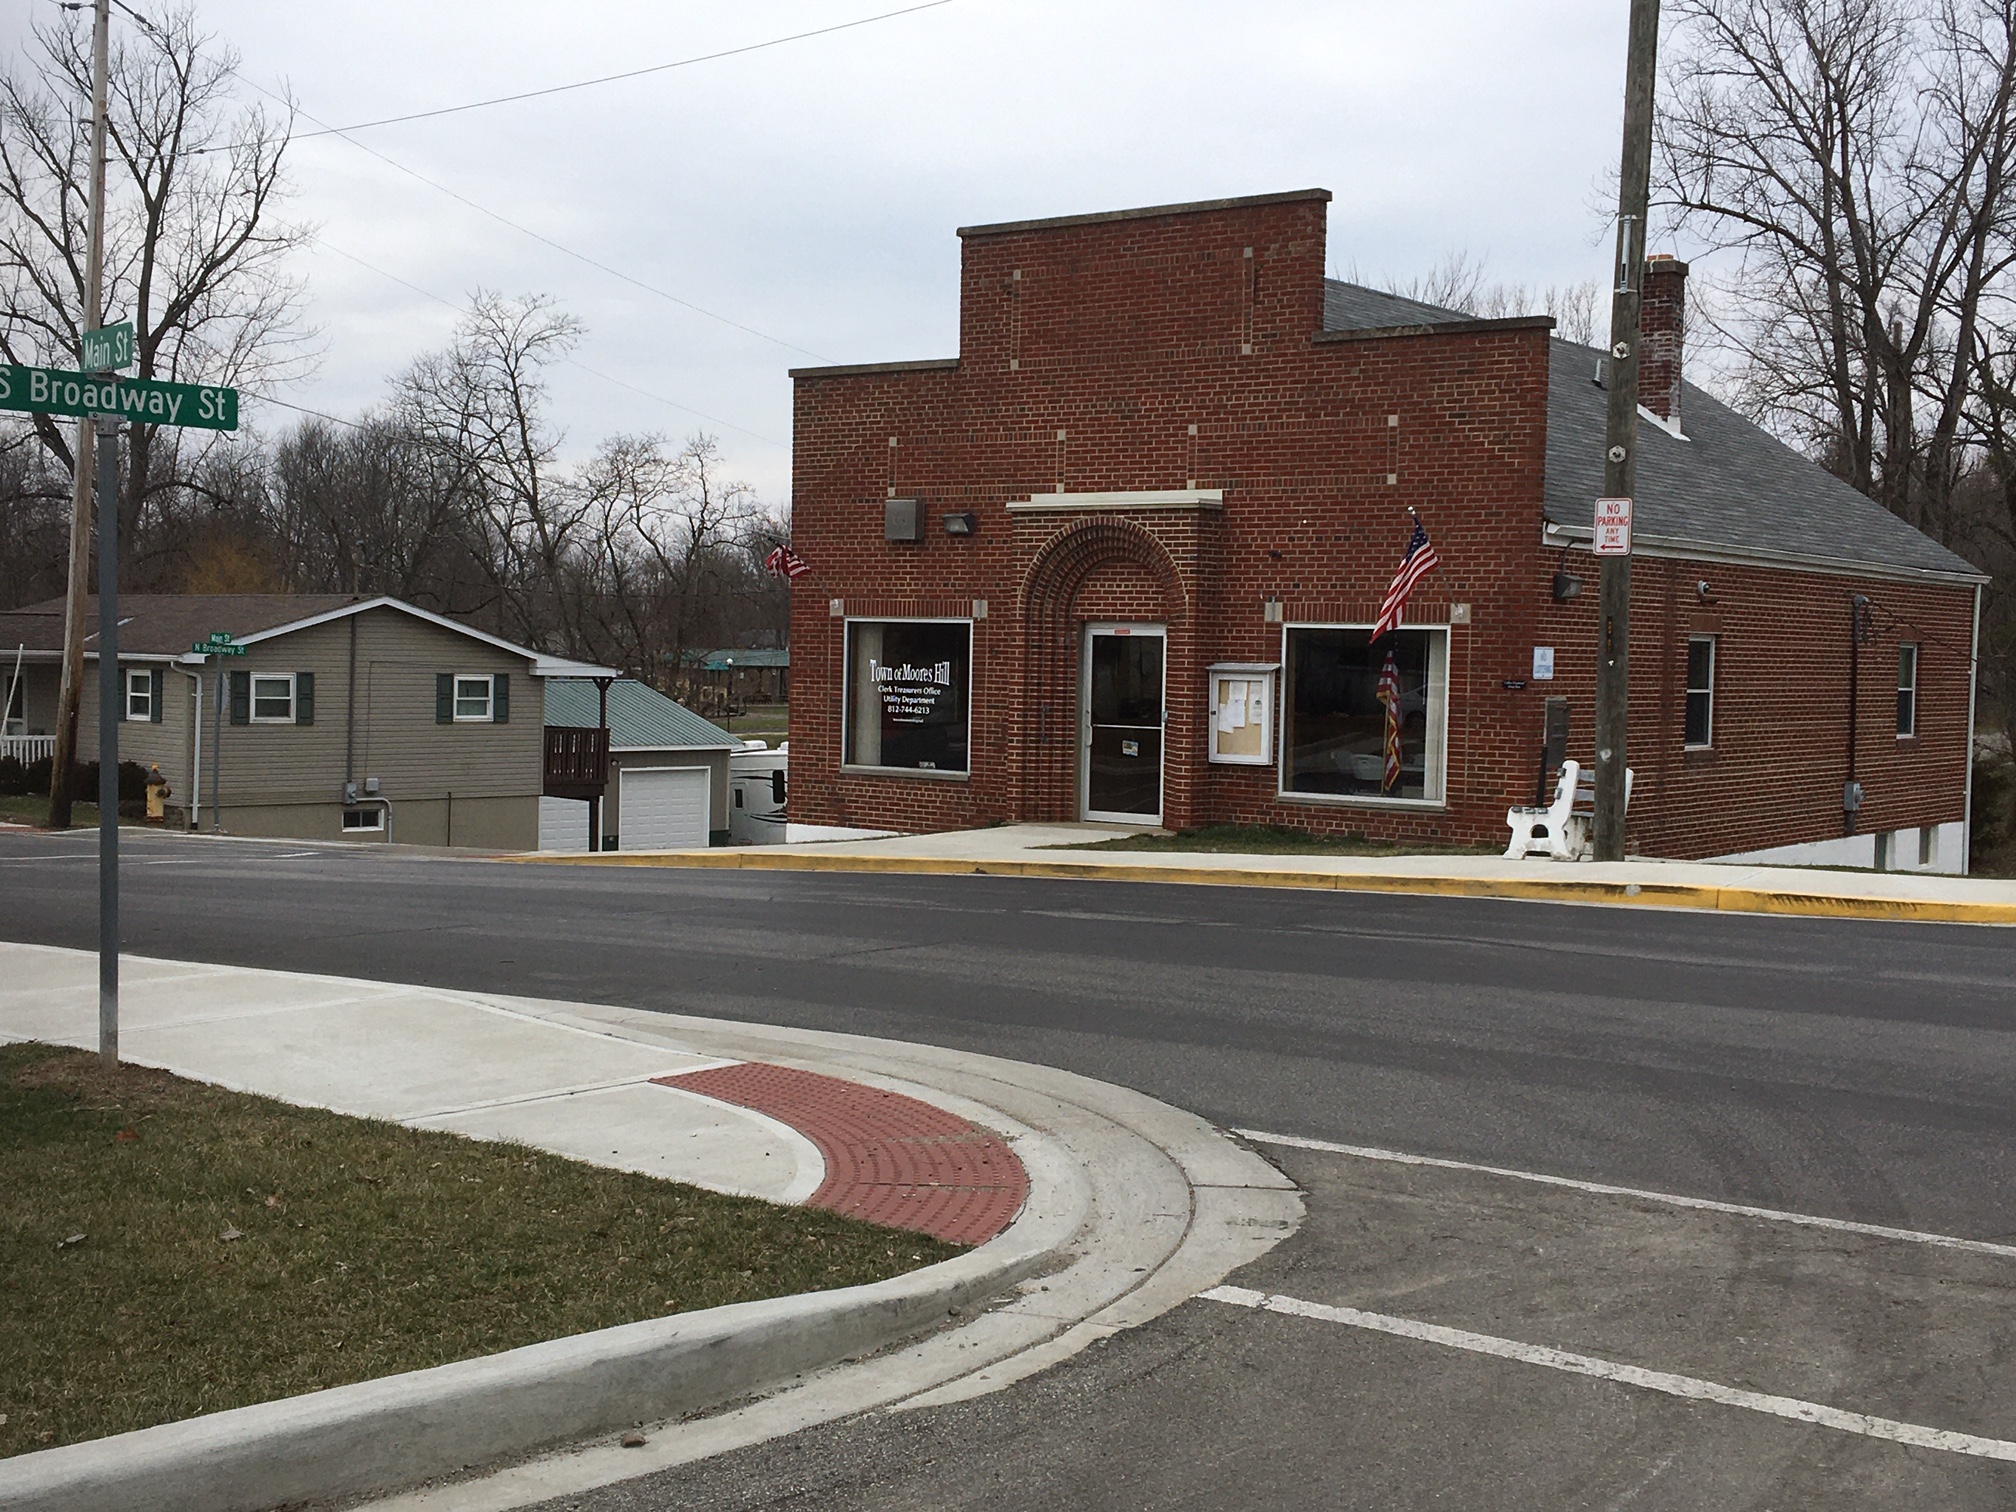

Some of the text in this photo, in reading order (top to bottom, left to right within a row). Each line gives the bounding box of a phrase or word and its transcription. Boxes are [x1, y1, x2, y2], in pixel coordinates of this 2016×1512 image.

[84, 331, 128, 369] Main St
[0, 367, 226, 423] S Broadway St
[1607, 504, 1620, 514] NO
[1597, 516, 1628, 526] PARKING
[211, 634, 230, 642] Main St
[194, 643, 245, 655] N Broadway St
[870, 659, 893, 682] Town
[902, 663, 933, 682] Moores
[934, 661, 950, 686] Hill
[877, 685, 893, 693] Clerk
[923, 687, 941, 695] Office
[883, 695, 935, 705] Utility Department
[887, 705, 930, 715] 812-744-6213
